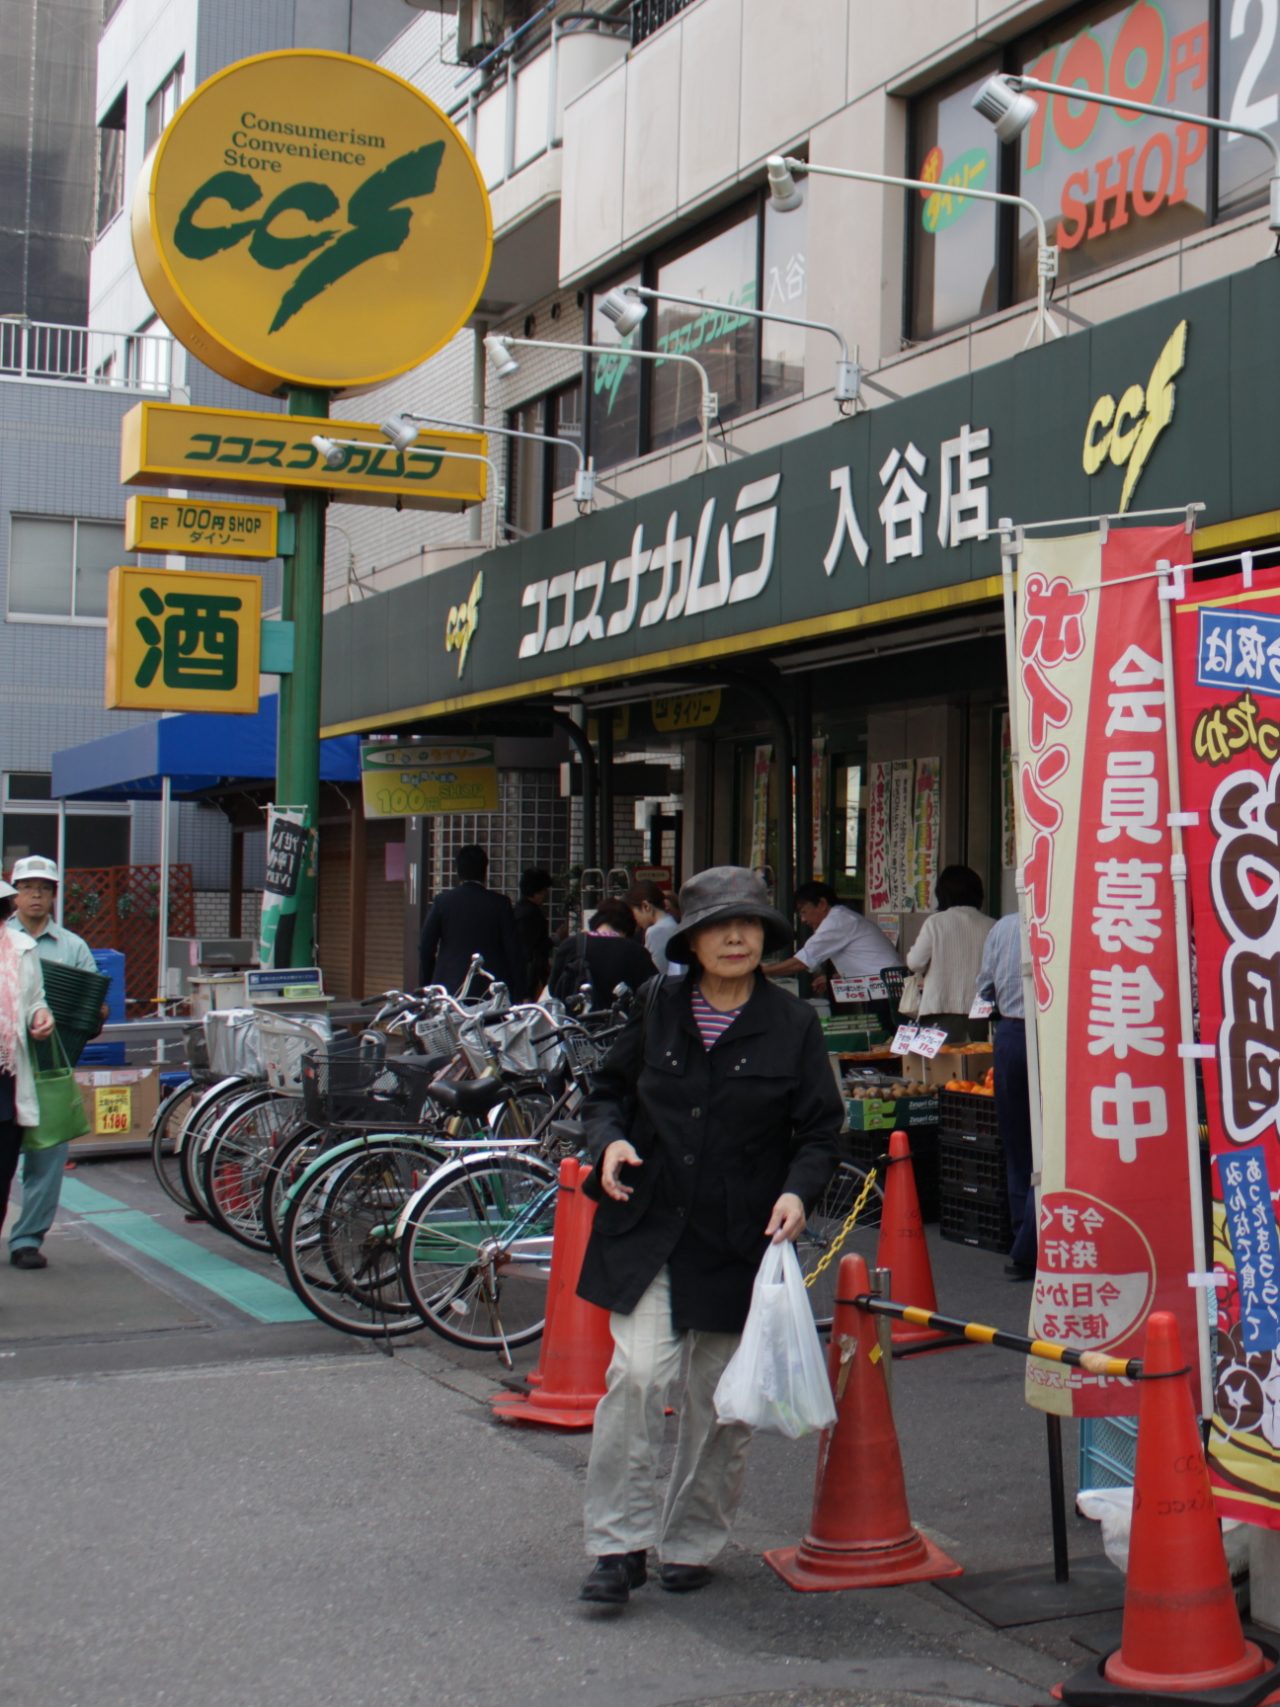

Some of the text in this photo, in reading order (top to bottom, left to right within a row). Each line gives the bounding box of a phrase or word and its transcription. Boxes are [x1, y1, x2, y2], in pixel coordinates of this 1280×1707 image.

[231, 131, 366, 167] Convenience
[240, 111, 386, 148] Consumerism
[223, 150, 282, 173] Store
[1057, 121, 1208, 252] SHOP
[767, 253, 806, 311] 入谷
[150, 507, 262, 534] 2F 100円 SHOP
[823, 424, 991, 577] 入谷店
[189, 531, 246, 546] ダイソー
[517, 472, 782, 659] ココスナカムラ
[135, 587, 243, 691] 酒
